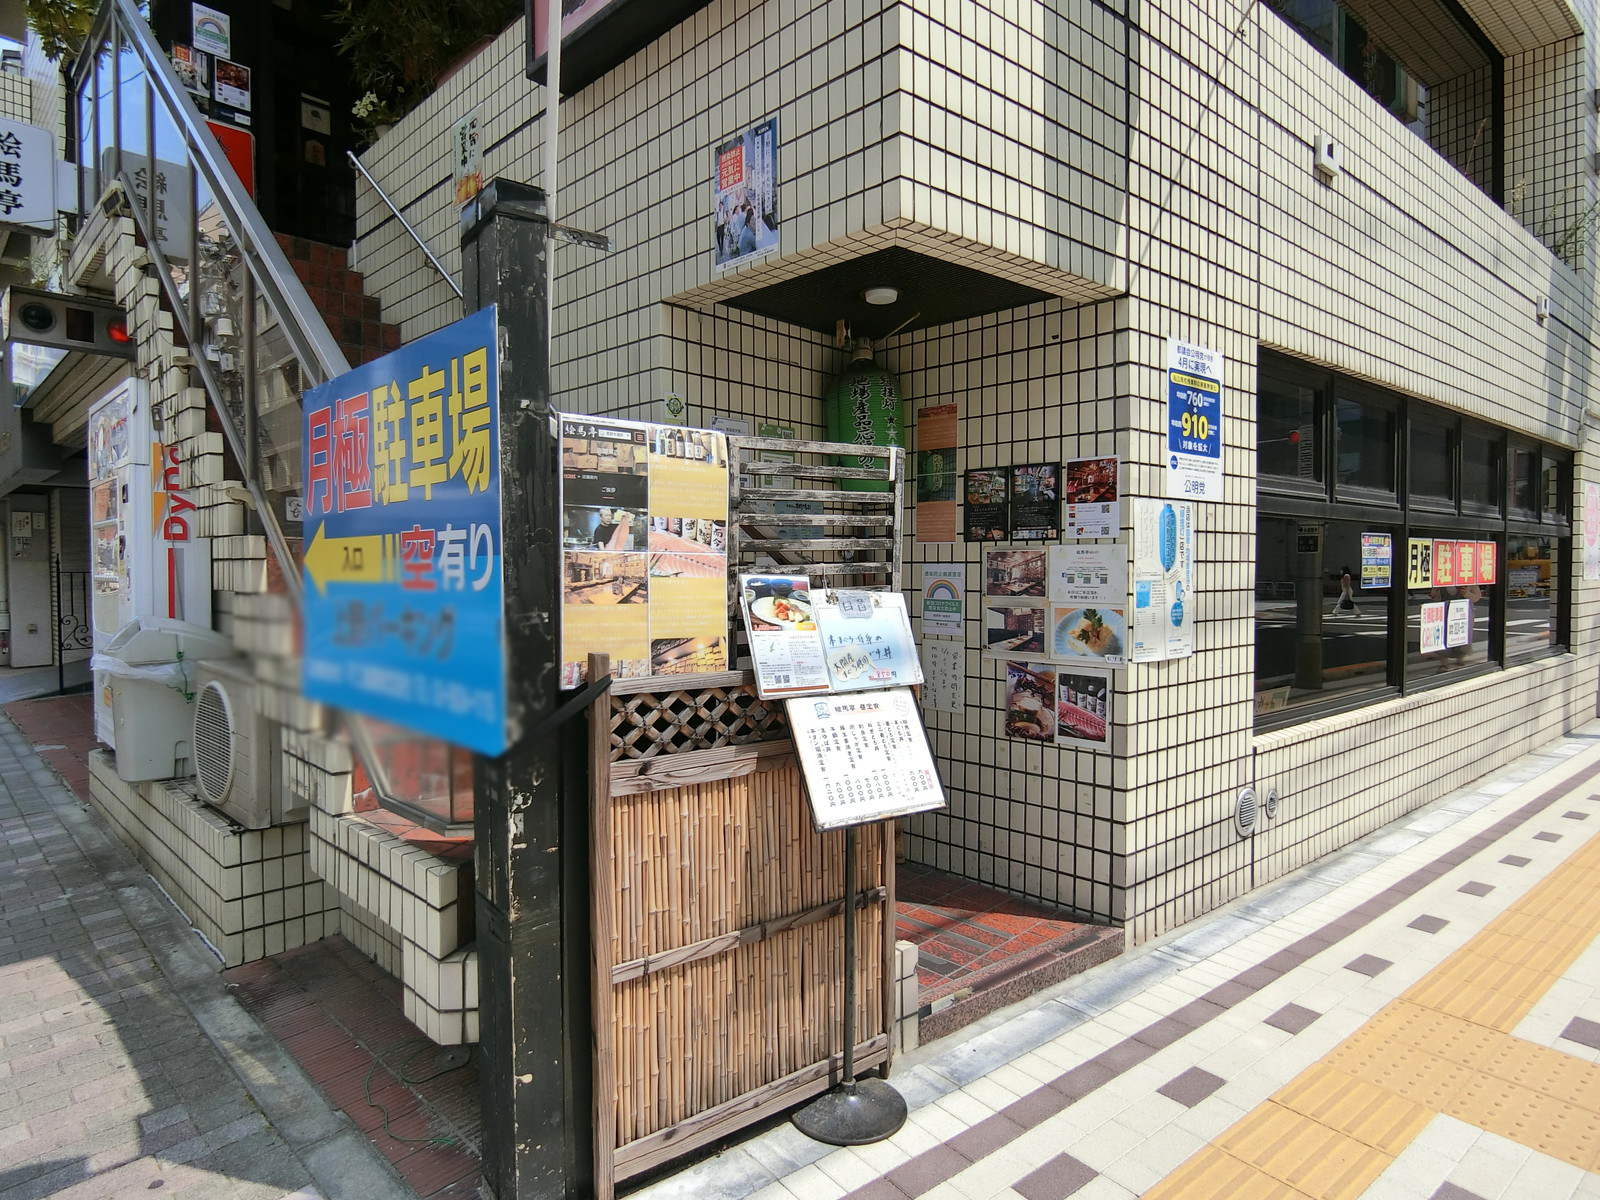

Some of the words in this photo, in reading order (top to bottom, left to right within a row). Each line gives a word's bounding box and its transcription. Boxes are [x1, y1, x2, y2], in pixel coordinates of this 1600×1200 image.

[721, 164, 741, 178] 元気に
[721, 173, 741, 189] 営業中
[1178, 357, 1212, 374] 4月に実現へ
[1187, 390, 1203, 407] 760
[306, 347, 491, 514] 月極駐車場
[849, 374, 876, 470] 地場産品応の
[1182, 412, 1208, 440] 910
[564, 424, 597, 438] 絵馬亭
[1182, 440, 1208, 452] 対象を拡大
[1184, 479, 1205, 494] 公明党
[342, 546, 363, 572] 入口
[401, 523, 494, 592] 空有り
[1408, 543, 1495, 585] 月極駐車場
